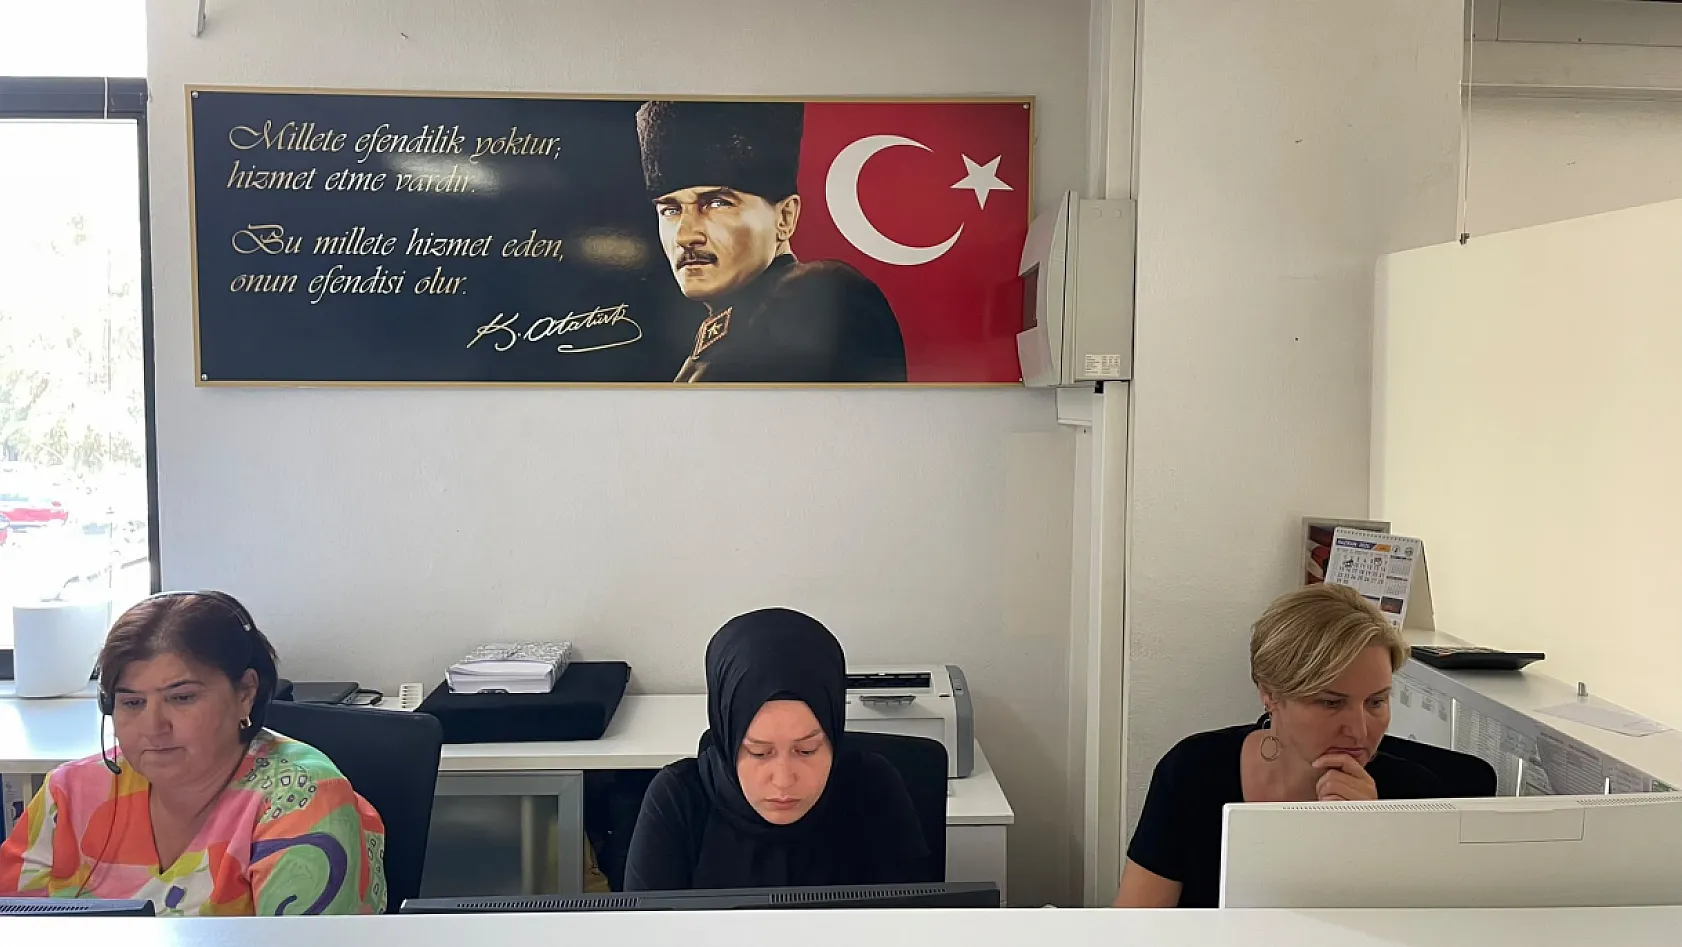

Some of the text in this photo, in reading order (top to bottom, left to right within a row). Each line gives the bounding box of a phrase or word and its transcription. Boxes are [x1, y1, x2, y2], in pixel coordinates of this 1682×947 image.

[228, 120, 562, 164] Millete efendilik yoktur;
[227, 160, 476, 193] hizmet etme vardır.
[231, 223, 564, 262] Bu millete hizmet eden,
[230, 264, 468, 304] onun efendisi olur.
